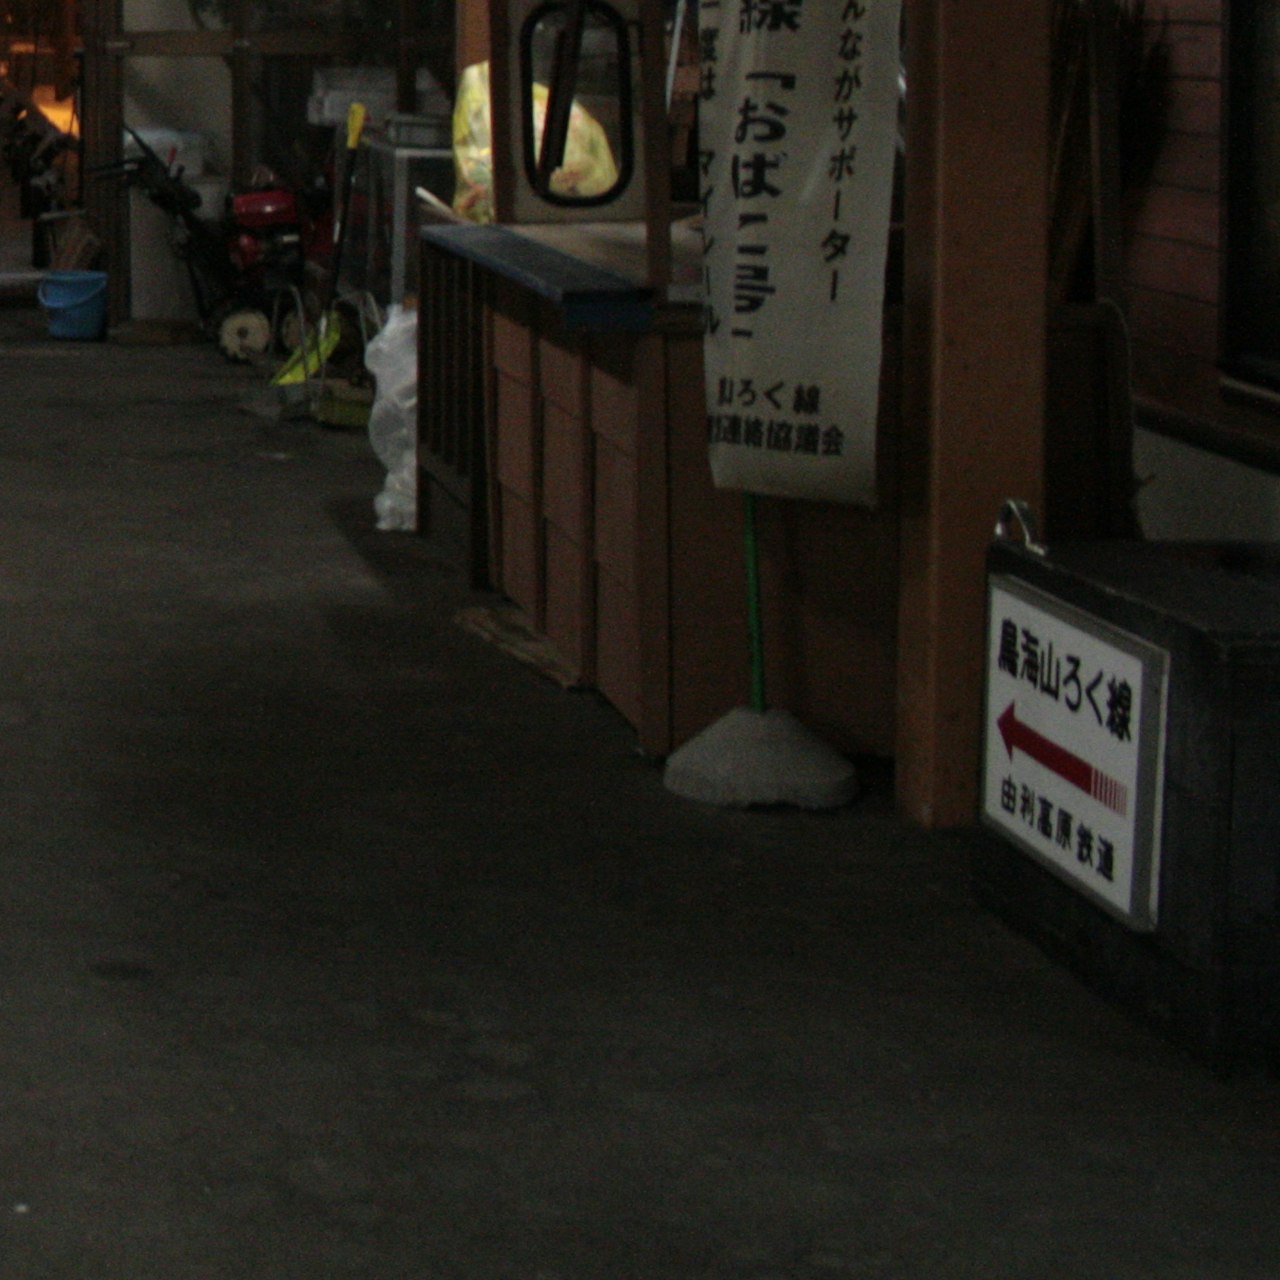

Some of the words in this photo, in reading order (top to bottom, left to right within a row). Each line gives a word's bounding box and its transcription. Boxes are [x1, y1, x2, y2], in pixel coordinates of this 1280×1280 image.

[997, 617, 1133, 743] 鳥海山ろく線
[1000, 775, 1115, 883] 由利高原鉄道
